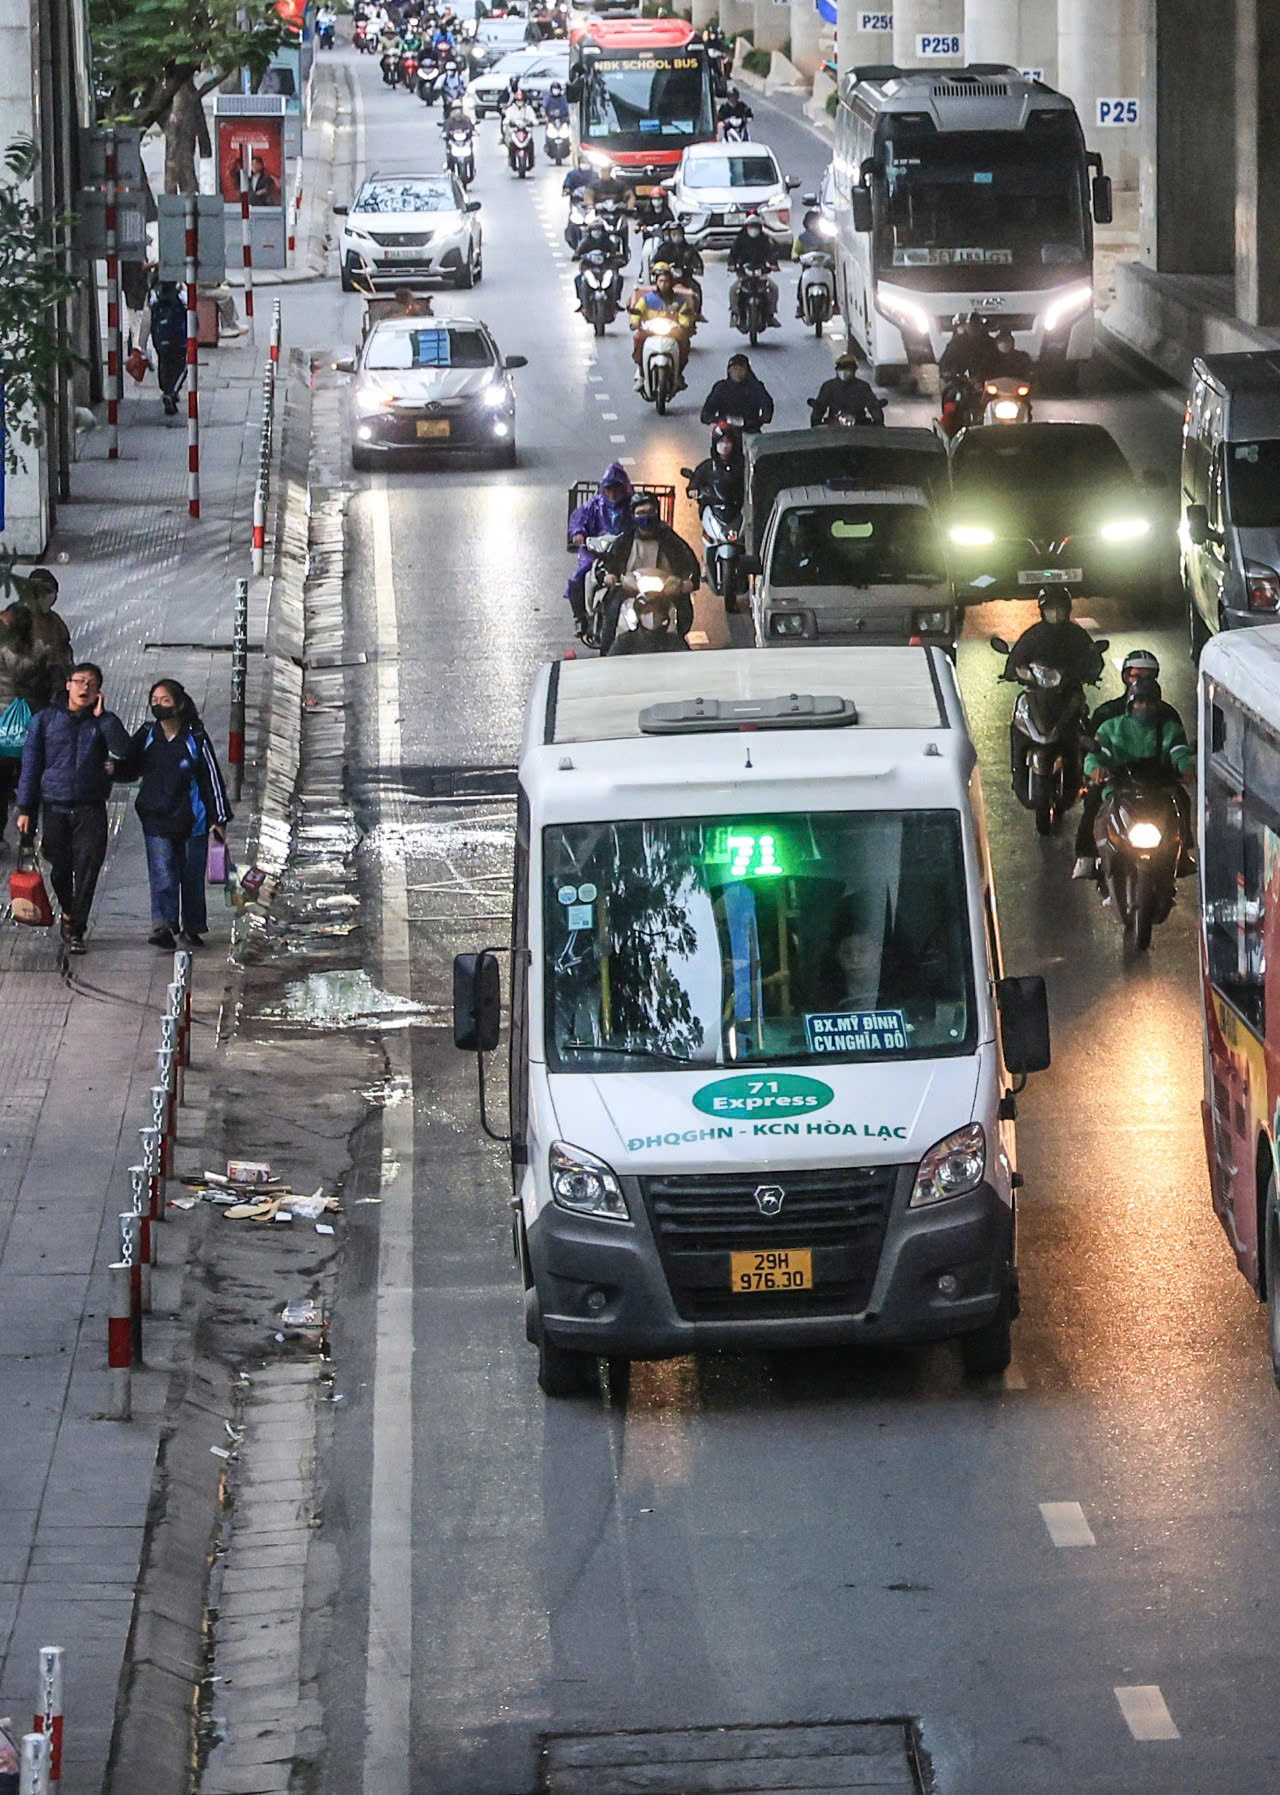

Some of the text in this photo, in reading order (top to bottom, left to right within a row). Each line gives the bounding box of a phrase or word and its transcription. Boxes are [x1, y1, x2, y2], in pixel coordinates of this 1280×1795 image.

[921, 36, 960, 54] P258
[622, 59, 672, 72] SCHOOL
[673, 58, 699, 70] BUS
[727, 835, 784, 876] 71
[812, 1013, 899, 1033] BX.MỸ ĐÌNH
[813, 1031, 882, 1052] CV.NGHĨA
[747, 1081, 778, 1094] 71
[712, 1093, 819, 1111] Express
[627, 1126, 733, 1152] ĐHQGHN
[753, 1122, 800, 1136] KCN
[806, 1119, 857, 1136] HÒA
[863, 1125, 908, 1141] LẠC
[754, 1252, 789, 1270] 29H
[740, 1270, 804, 1290] 976.30
